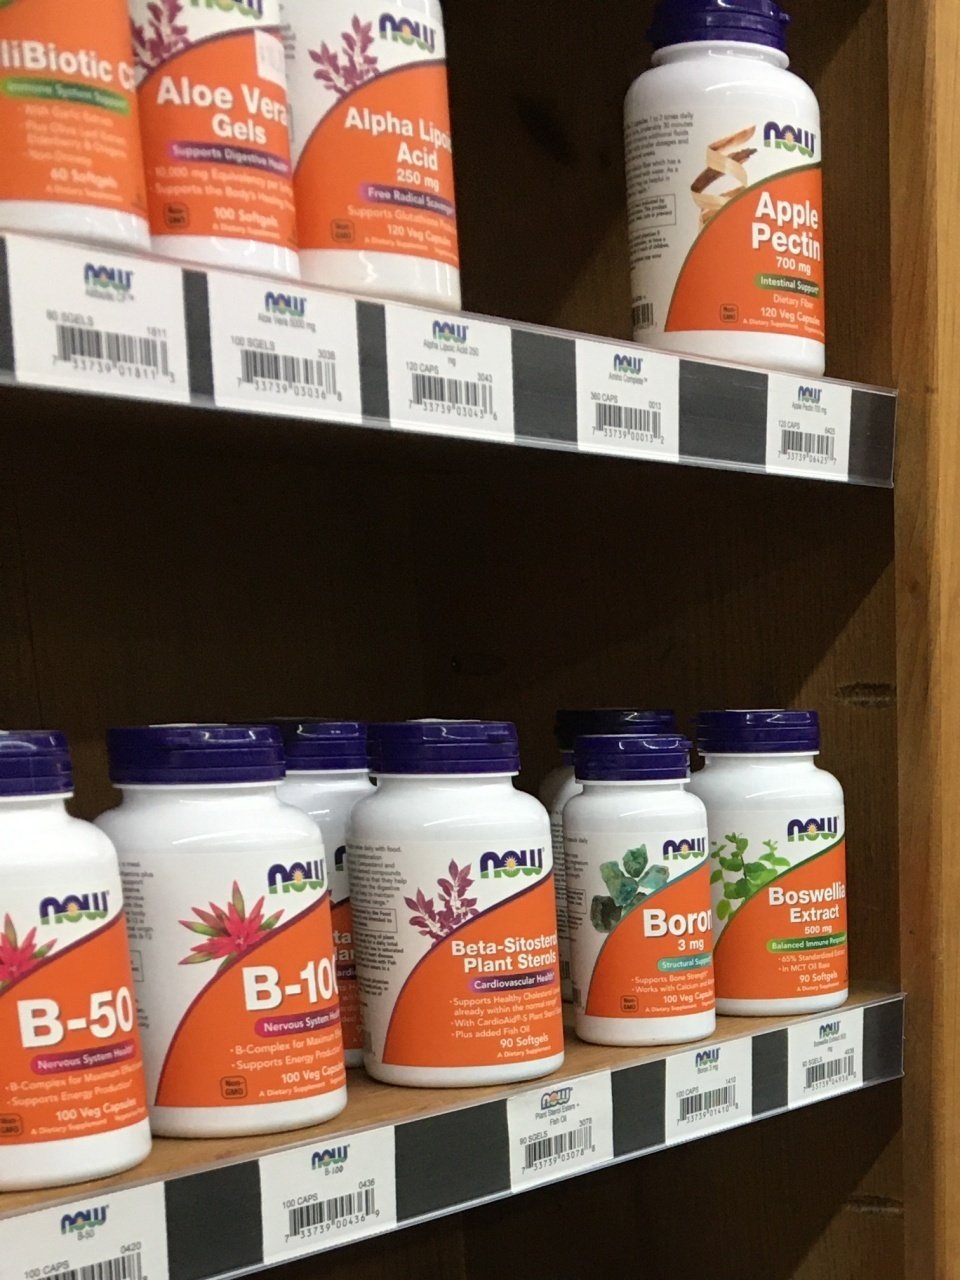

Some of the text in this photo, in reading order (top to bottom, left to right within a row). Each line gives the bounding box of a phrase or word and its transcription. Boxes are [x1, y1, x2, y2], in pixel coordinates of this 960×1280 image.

[157, 77, 234, 109] Aloe
[212, 114, 267, 143] Gels
[344, 107, 413, 137] Alpha
[397, 142, 438, 170] Acid
[396, 169, 421, 184] 250
[755, 192, 818, 230] Apple
[752, 223, 821, 262] Pectin
[776, 257, 795, 270] 700
[760, 275, 795, 289] Intestinal
[769, 883, 845, 906] Boswellia
[790, 905, 840, 923] Extract
[804, 924, 833, 935] 500 mg
[678, 938, 704, 952] 3 mg
[772, 938, 826, 950] Balanced Immune
[464, 950, 557, 973] Plant Sterols
[662, 959, 694, 969] Structural
[474, 976, 535, 989] Cardiovascular
[812, 971, 838, 982] Softgels
[453, 997, 491, 1008] Supports
[664, 994, 678, 1004] 100
[17, 986, 134, 1048] B-50
[454, 1007, 486, 1017] already
[264, 1014, 329, 1033] Nervous System
[475, 1024, 530, 1037] added Fish Oil
[235, 1040, 290, 1055] B-Complex
[500, 1033, 549, 1048] 90 Softgels
[37, 1049, 113, 1070] Nervous System
[237, 1052, 314, 1072] Supports Energy
[281, 1069, 320, 1084] 100 Veg
[56, 1105, 101, 1122] 100 Veg
[282, 1193, 318, 1209] 100 CAPS
[300, 1222, 330, 1239] 33739
[24, 1260, 69, 1279] 100 CAPS
